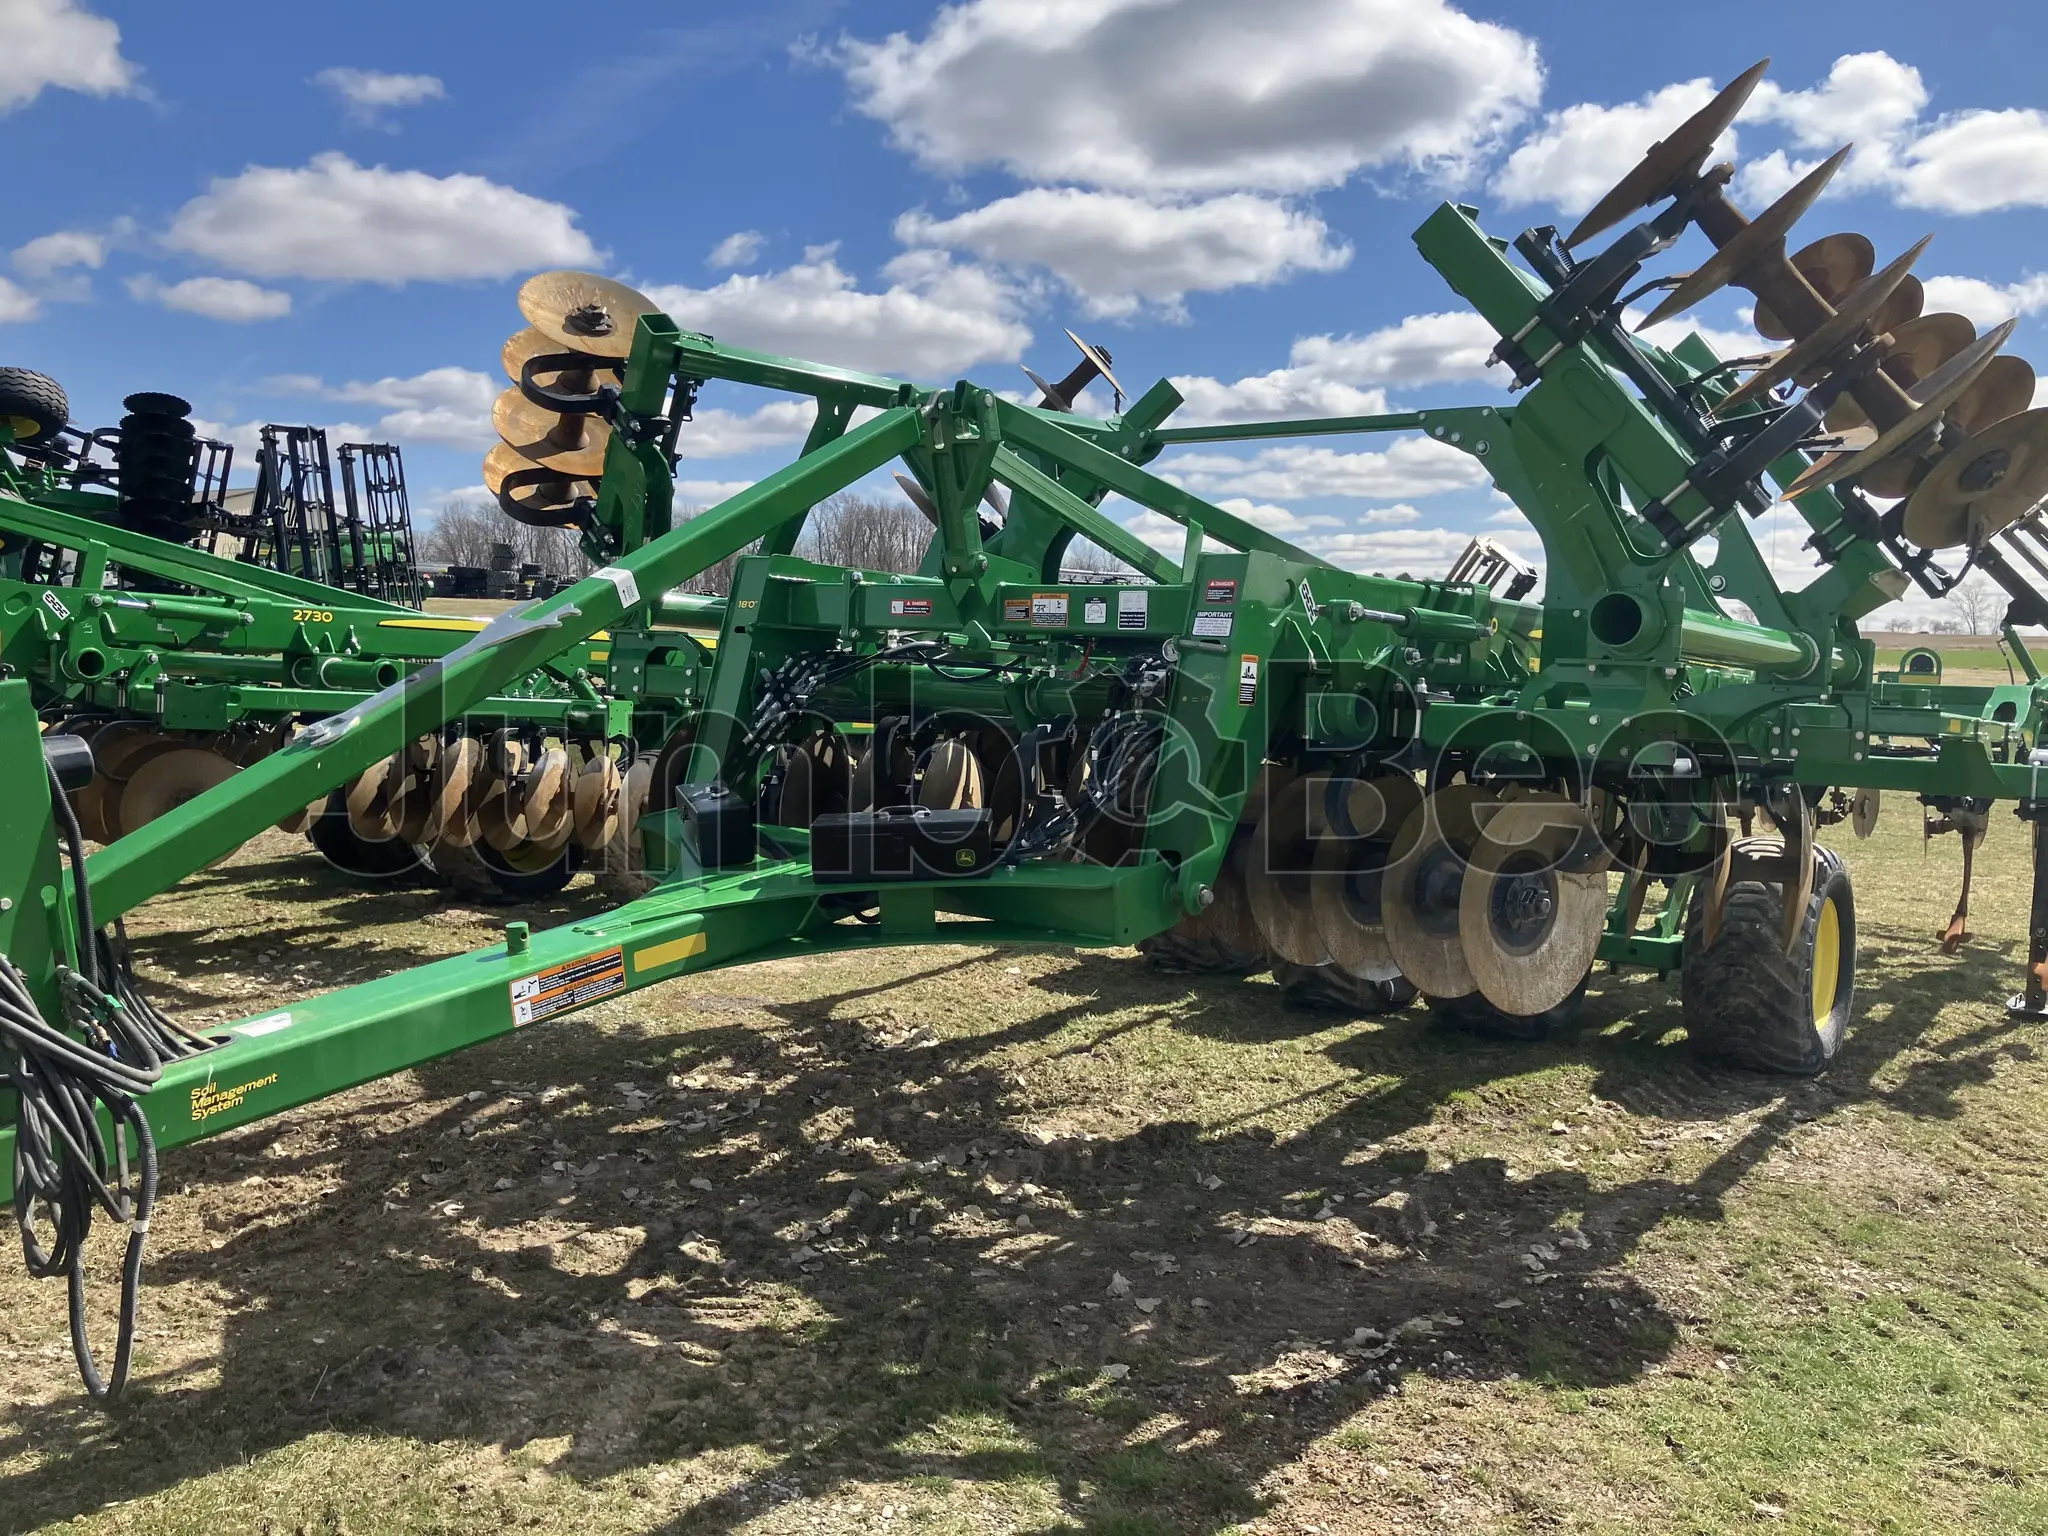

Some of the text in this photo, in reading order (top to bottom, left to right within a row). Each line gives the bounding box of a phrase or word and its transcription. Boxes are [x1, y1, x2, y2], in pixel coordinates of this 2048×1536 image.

[293, 609, 333, 623] 2730
[565, 956, 592, 969] WARNING
[568, 977, 594, 990] WARNING
[190, 1081, 217, 1100] Soil
[191, 1072, 279, 1110] Management
[191, 1095, 244, 1121] System
